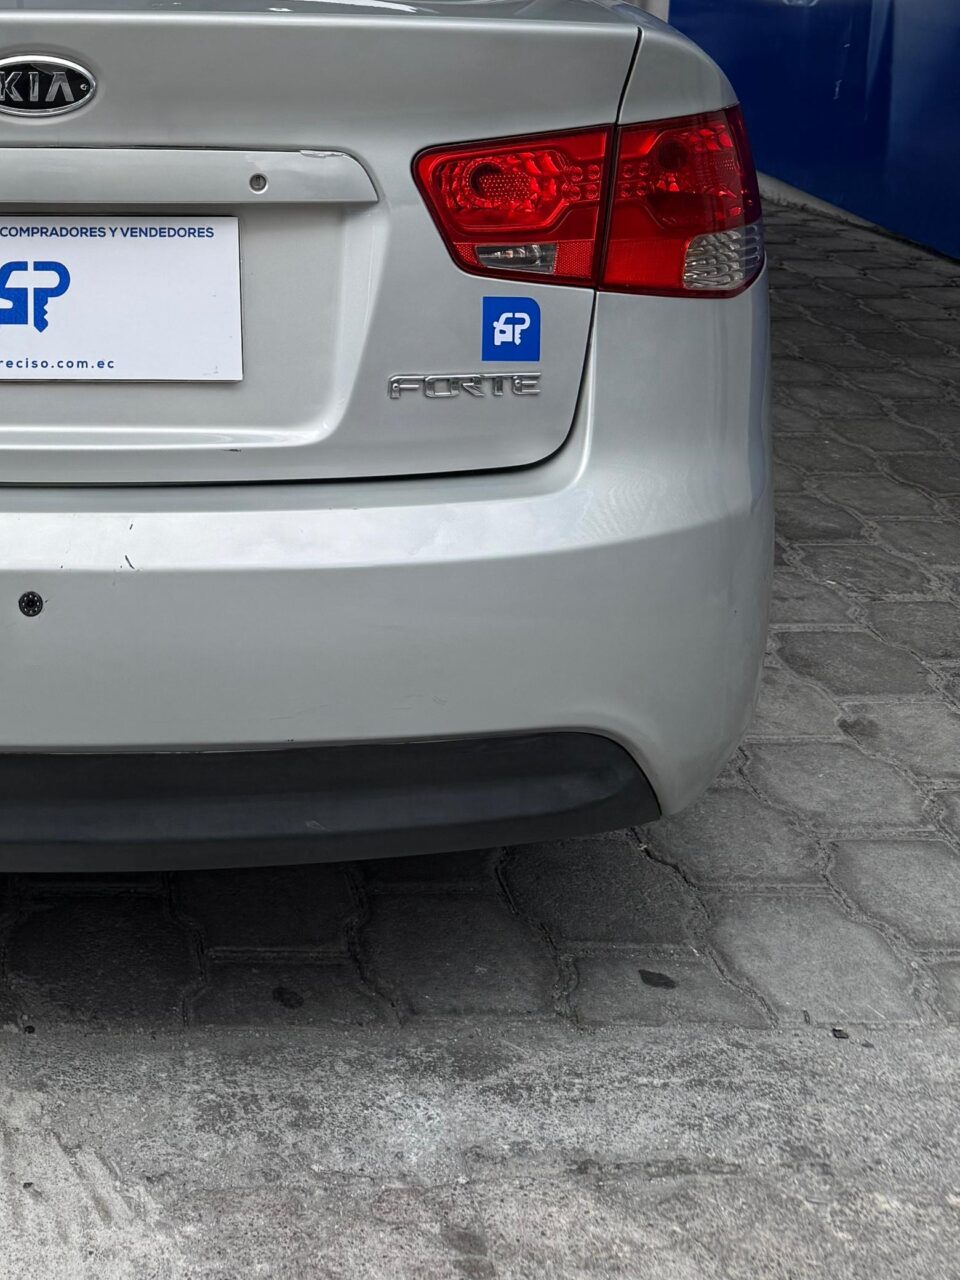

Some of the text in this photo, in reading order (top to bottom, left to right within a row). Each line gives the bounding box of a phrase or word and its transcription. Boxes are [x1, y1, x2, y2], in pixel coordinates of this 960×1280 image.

[0, 226, 106, 238] COMPRADORES
[108, 226, 119, 238] Y
[120, 226, 215, 238] VENDEDORES
[388, 372, 542, 400] FORTE
